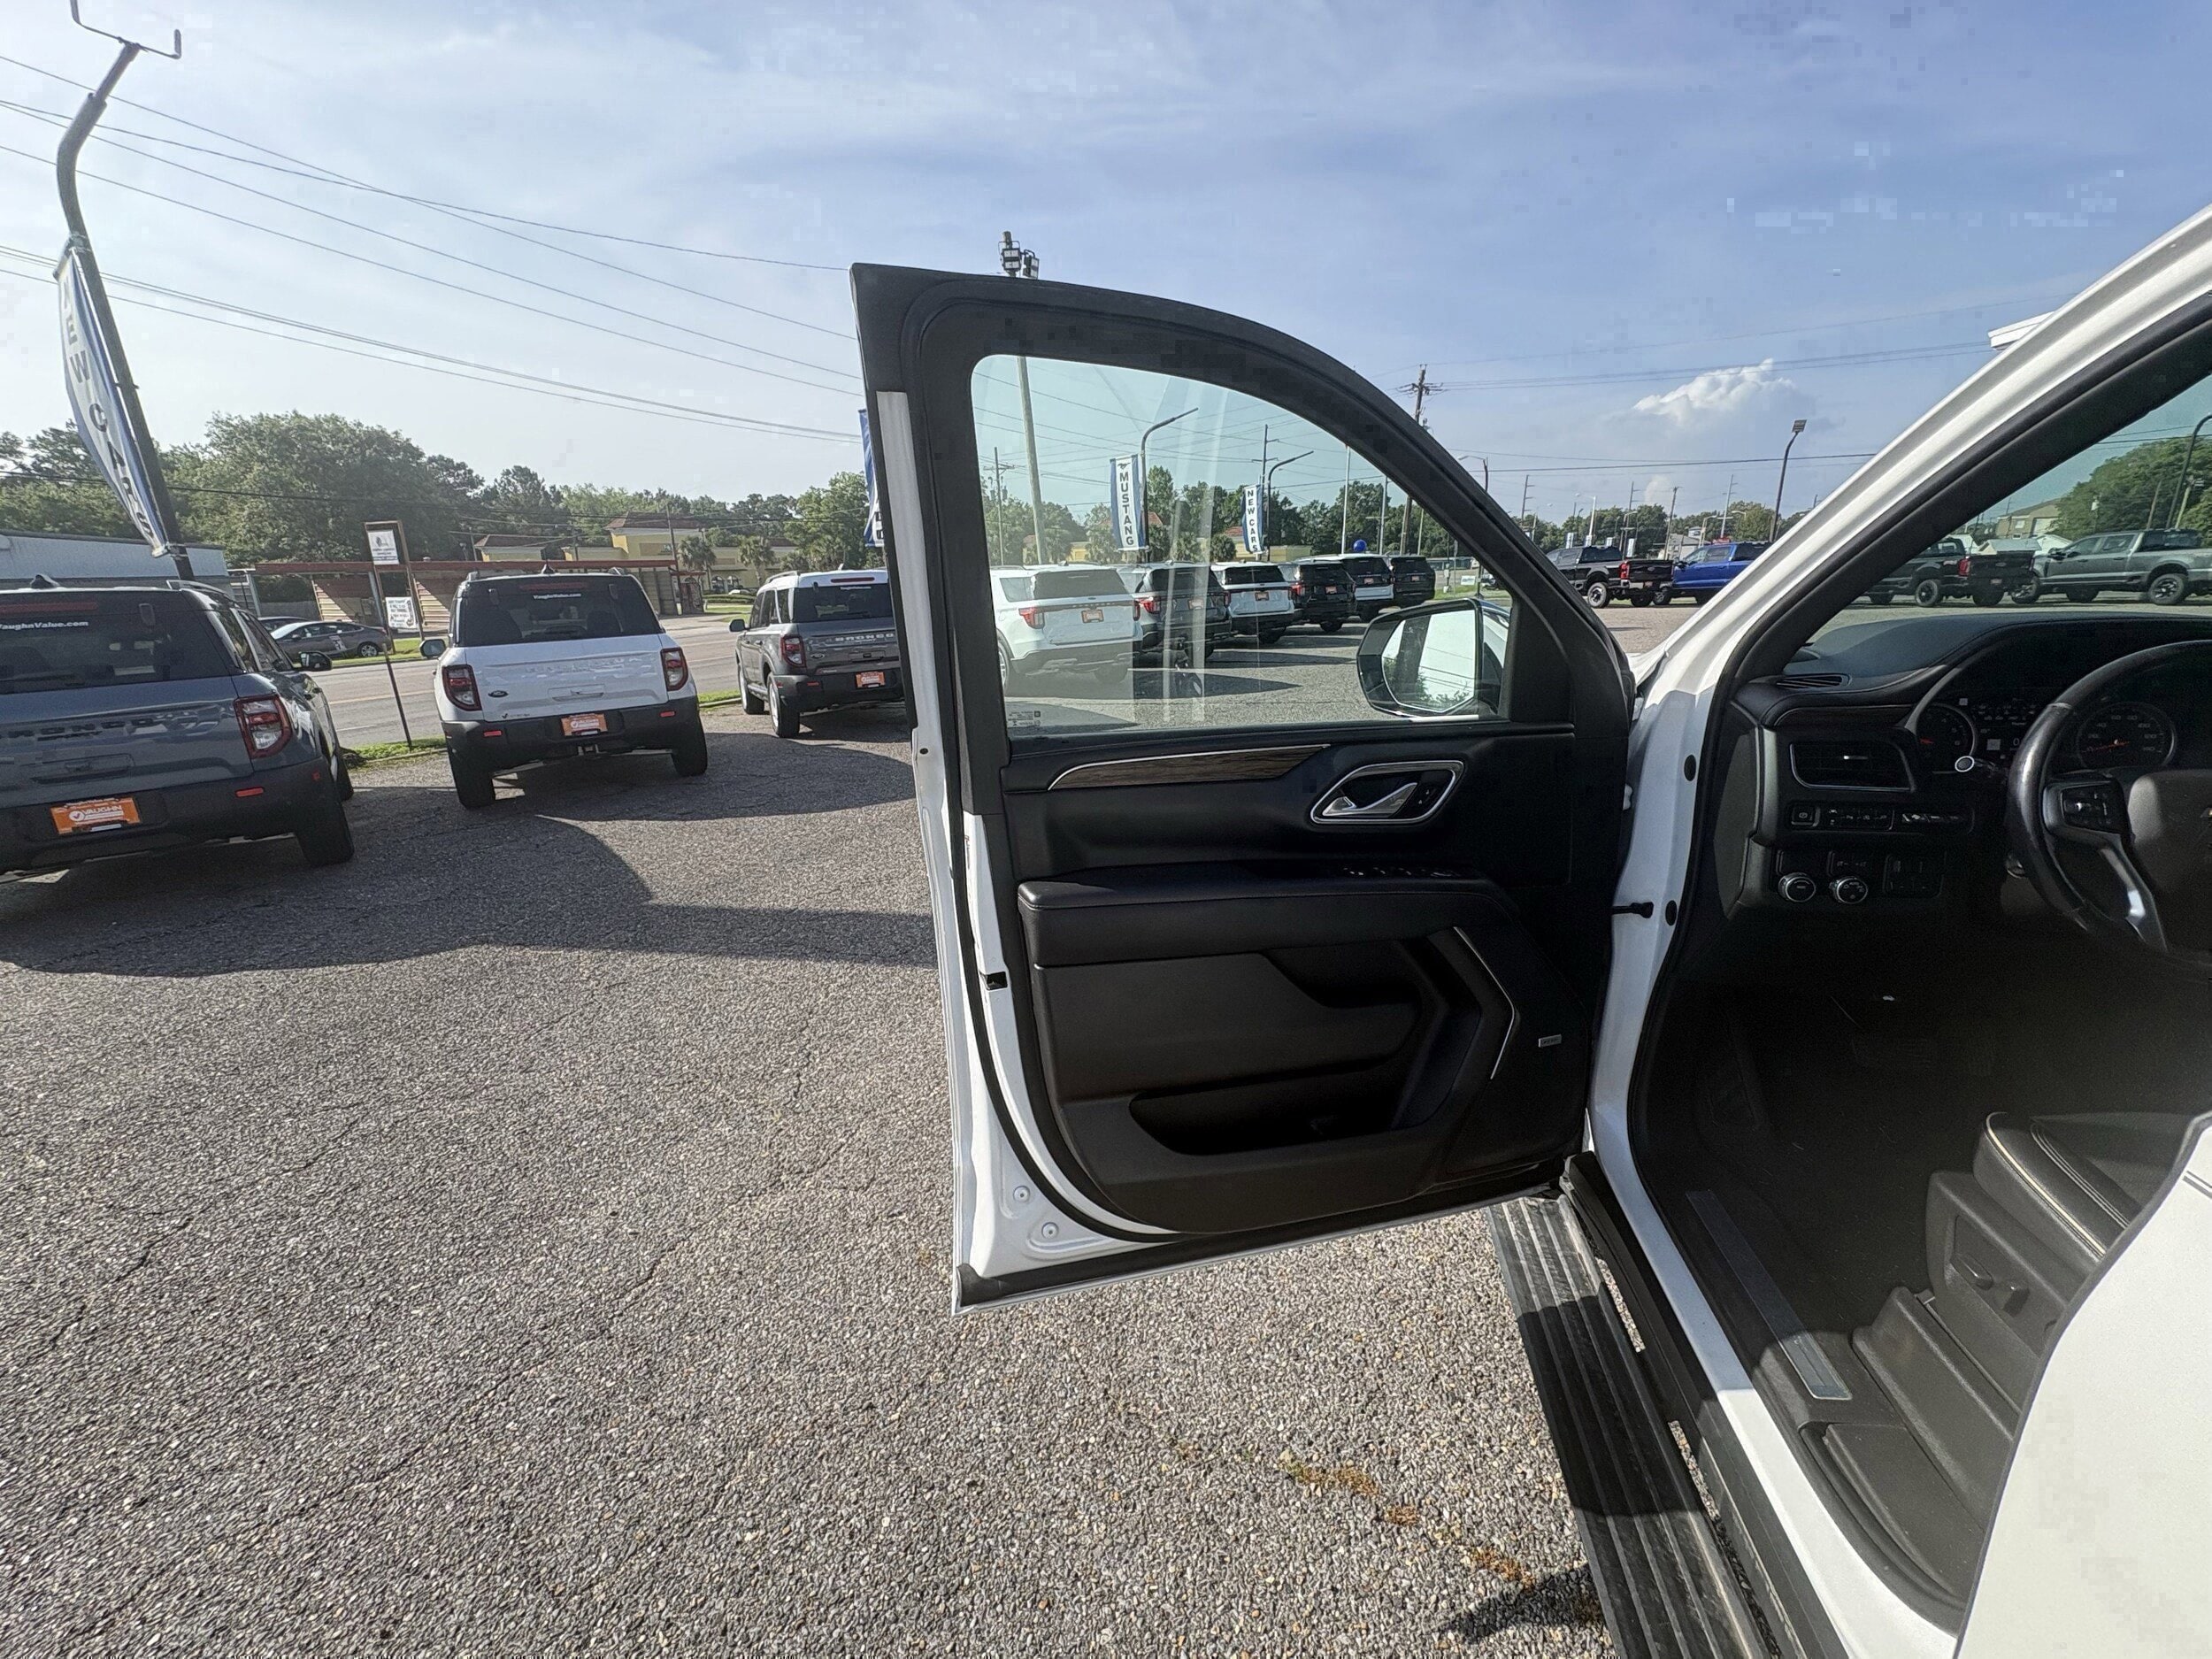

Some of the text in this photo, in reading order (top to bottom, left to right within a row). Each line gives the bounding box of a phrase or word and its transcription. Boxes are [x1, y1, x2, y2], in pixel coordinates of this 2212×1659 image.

[89, 403, 154, 538] CARS
[1119, 472, 1134, 546] MUSTANG
[1247, 490, 1258, 551] NEW CARS
[0, 718, 153, 740] RONCO
